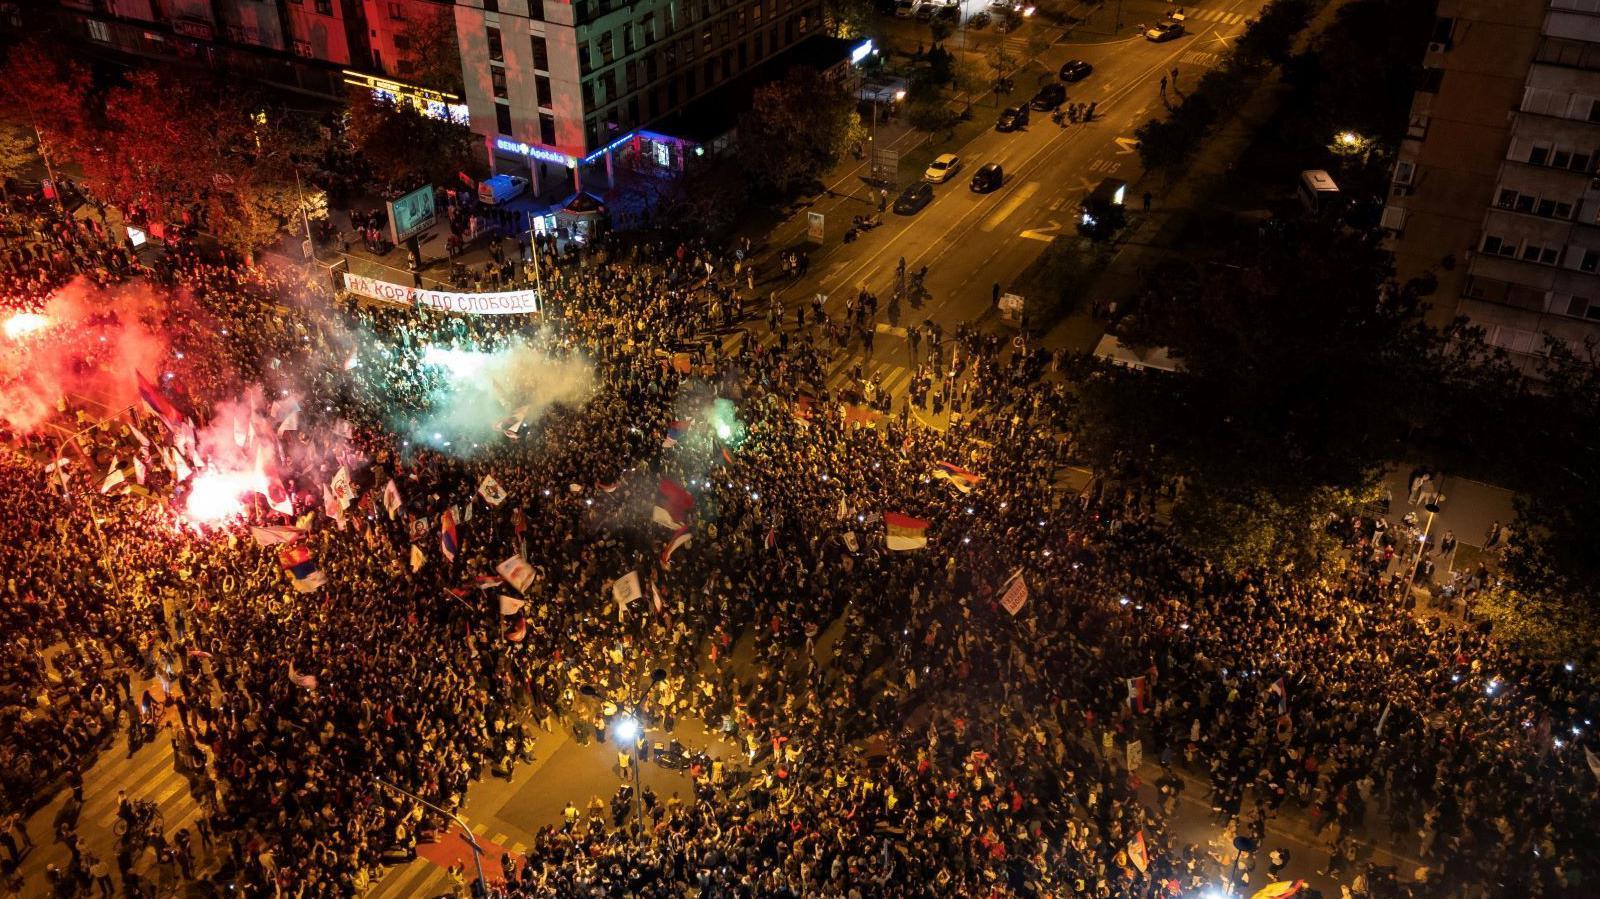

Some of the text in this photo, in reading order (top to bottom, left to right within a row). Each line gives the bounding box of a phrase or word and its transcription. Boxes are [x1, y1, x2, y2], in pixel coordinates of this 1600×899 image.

[497, 139, 564, 163] BENU Apoteka
[1089, 159, 1121, 174] BUS
[348, 276, 371, 293] НА
[431, 294, 452, 310] ДО
[458, 293, 534, 311] СЛОБОДЕ
